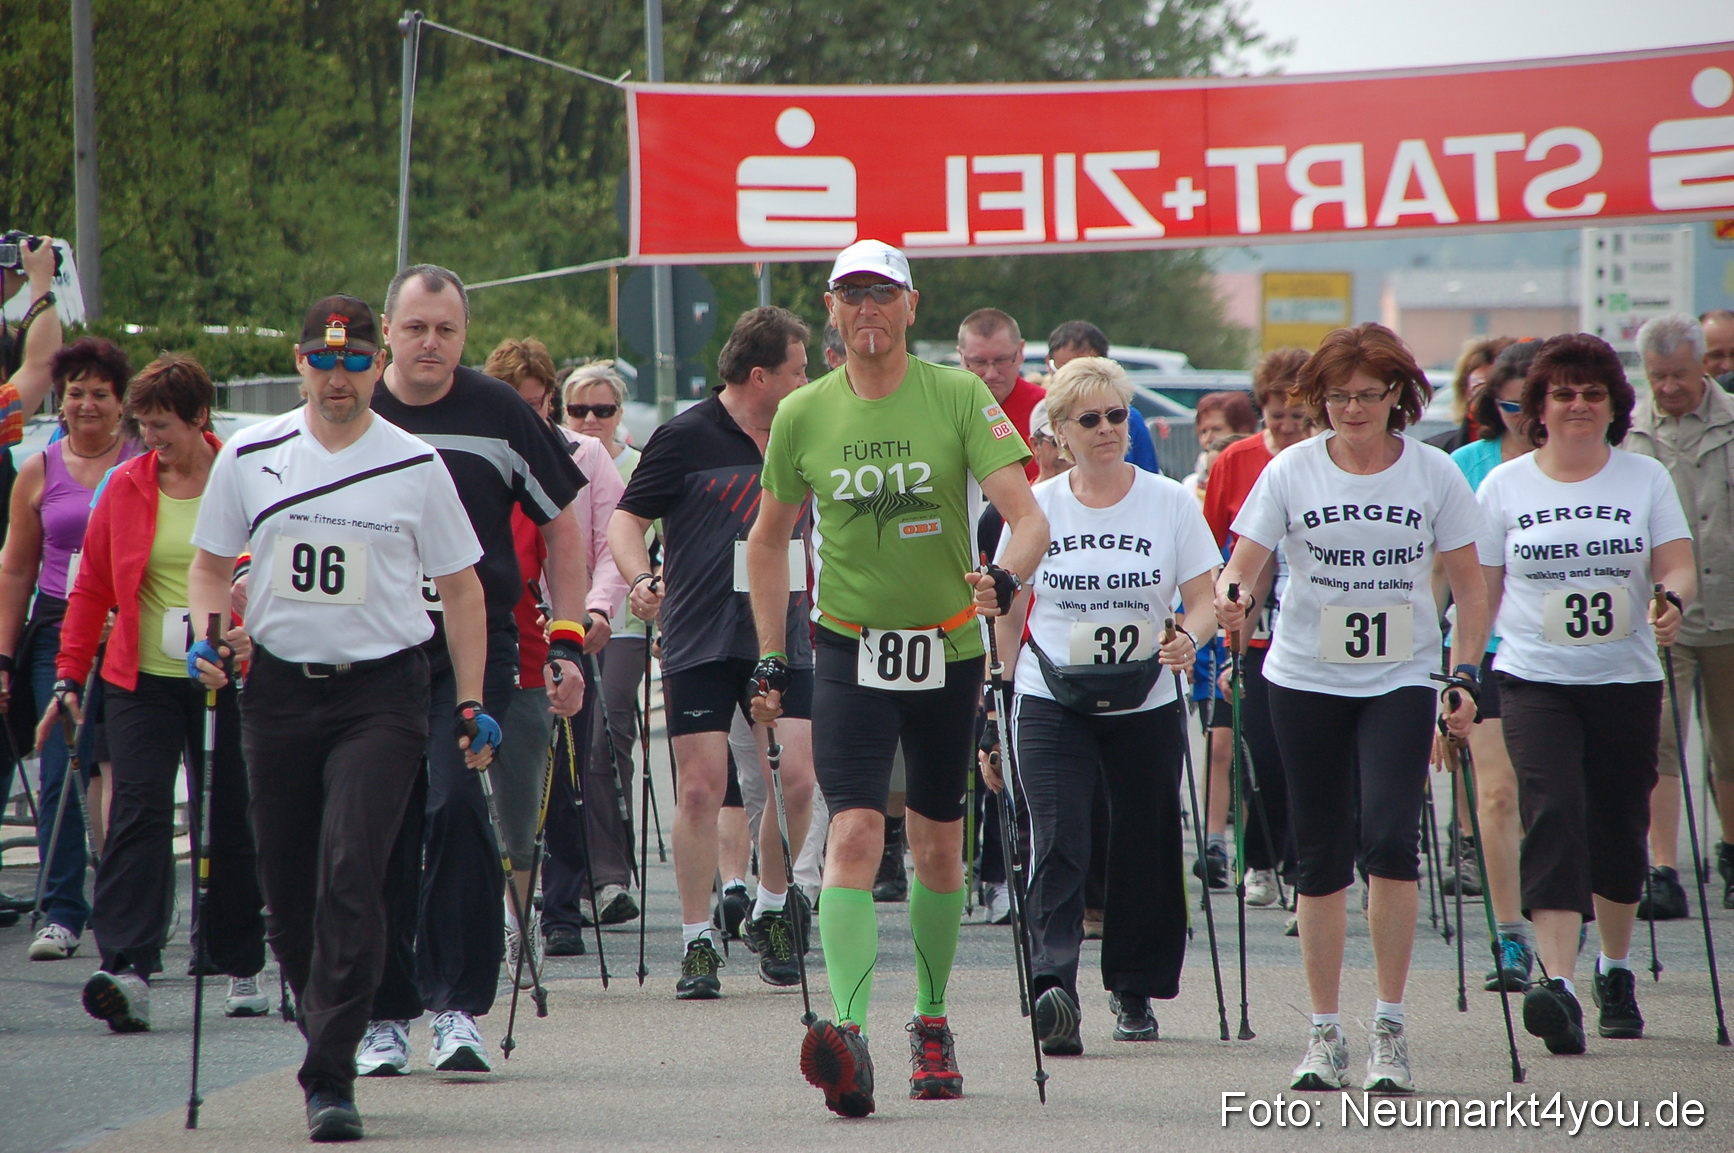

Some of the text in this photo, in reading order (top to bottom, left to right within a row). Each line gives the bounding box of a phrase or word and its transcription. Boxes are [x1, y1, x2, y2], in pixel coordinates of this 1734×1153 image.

[993, 423, 1010, 438] DB
[843, 440, 912, 462] FÜRTH
[830, 461, 933, 501] 2012
[903, 522, 939, 535] OBI
[1303, 504, 1422, 530] BERGER
[1518, 505, 1632, 530] BERGER
[1047, 534, 1152, 557] BERGER
[1304, 539, 1424, 566] POWER GIRLS
[1514, 537, 1644, 560] POWER GIRLS
[292, 543, 345, 595] 96
[1043, 569, 1161, 590] POWER GIRLS
[1569, 568, 1591, 578] and
[1594, 567, 1631, 578] talking
[1310, 575, 1350, 592] walking
[1353, 580, 1374, 590] and
[1090, 600, 1109, 611] and
[1112, 600, 1150, 611] talking
[1565, 591, 1614, 638] 33
[1093, 624, 1140, 665] 32
[1345, 612, 1388, 658] 31
[877, 632, 931, 683] 80
